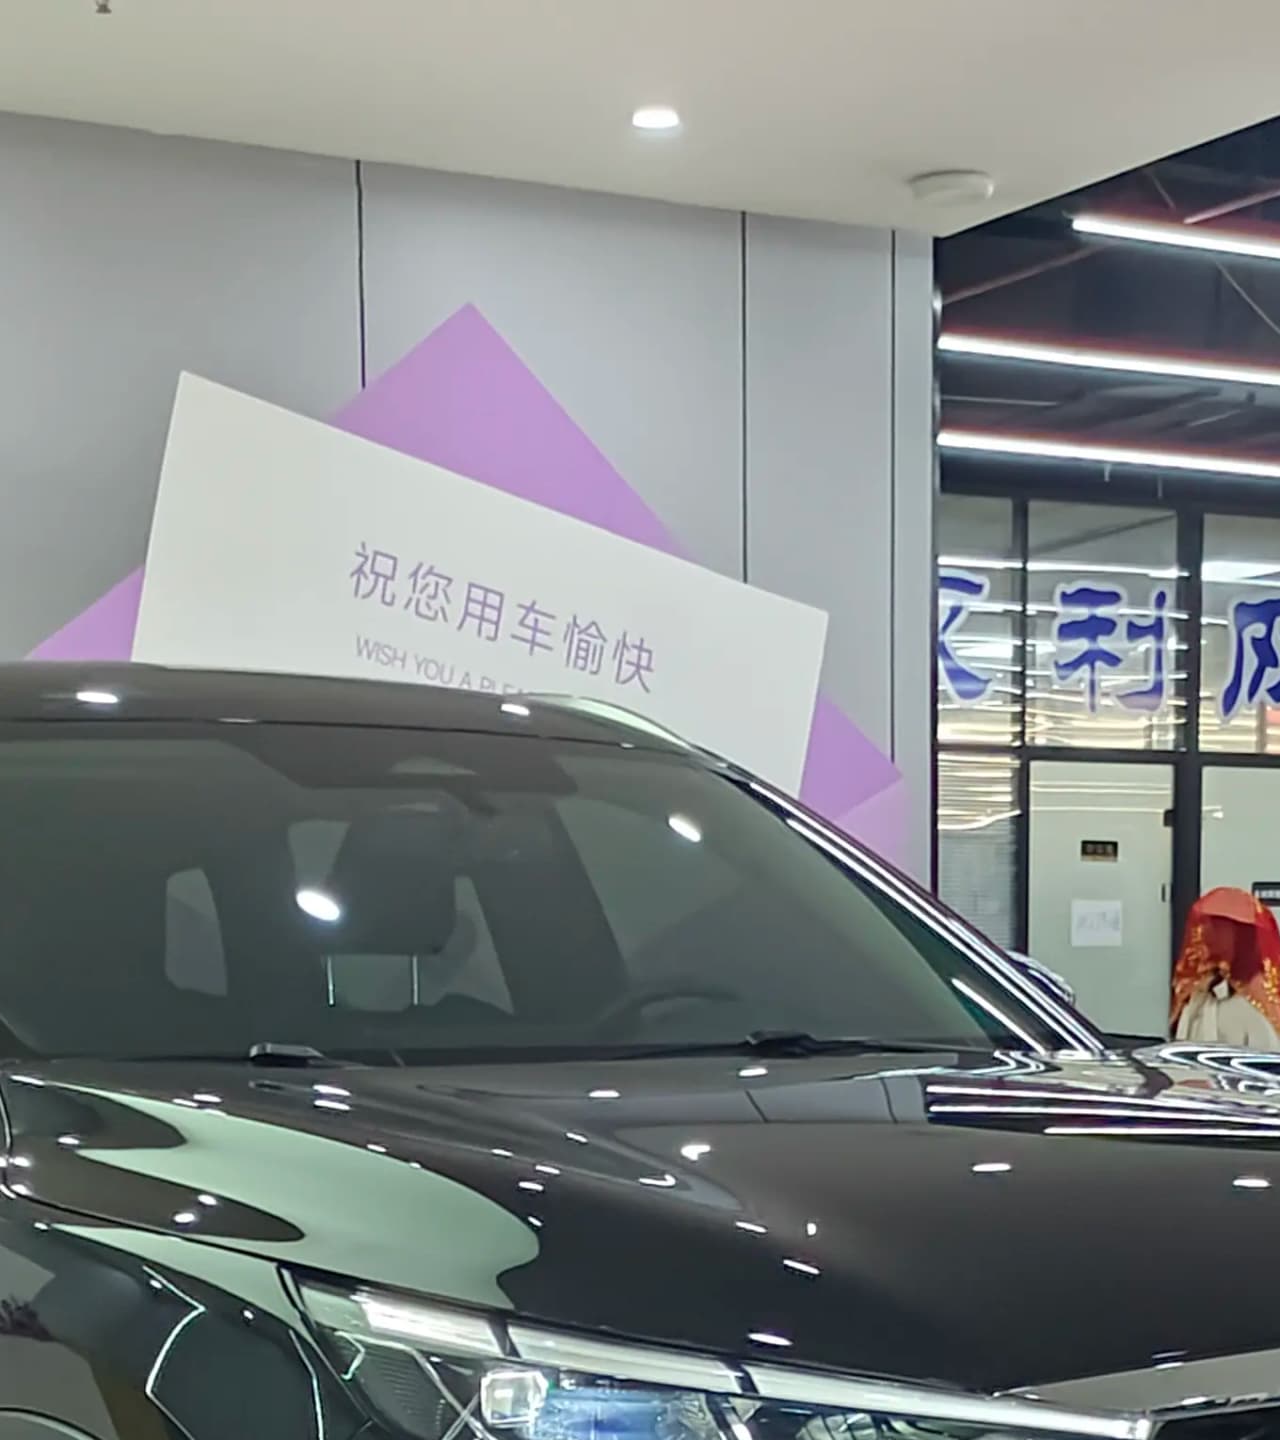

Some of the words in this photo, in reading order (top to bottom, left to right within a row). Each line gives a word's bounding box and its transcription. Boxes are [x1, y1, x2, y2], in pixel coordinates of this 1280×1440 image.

[349, 541, 655, 694] 祝您用车愉快
[356, 634, 407, 669] WISH
[413, 655, 455, 686] YOU
